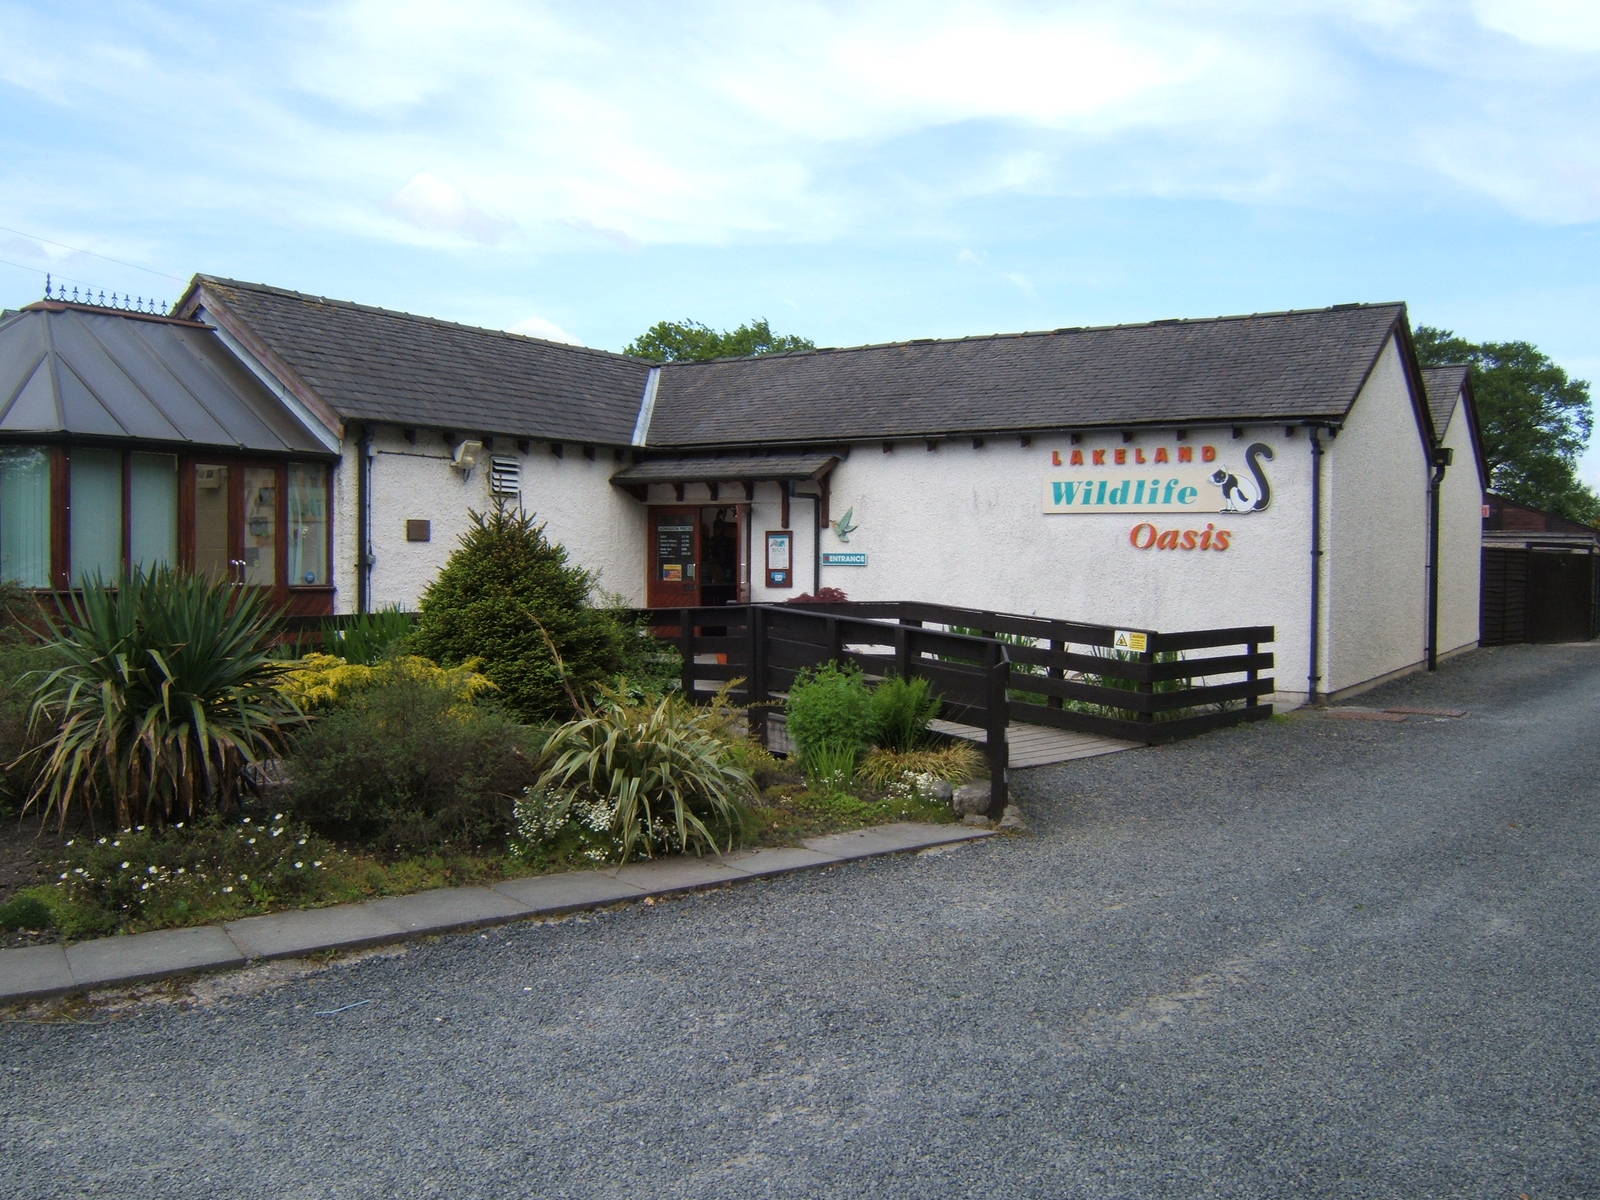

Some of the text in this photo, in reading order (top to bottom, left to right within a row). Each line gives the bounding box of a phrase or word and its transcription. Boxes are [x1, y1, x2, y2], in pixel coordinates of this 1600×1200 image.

[1052, 445, 1216, 465] LAKELAND
[1052, 479, 1198, 504] Wildlife
[1130, 523, 1231, 550] Oasis
